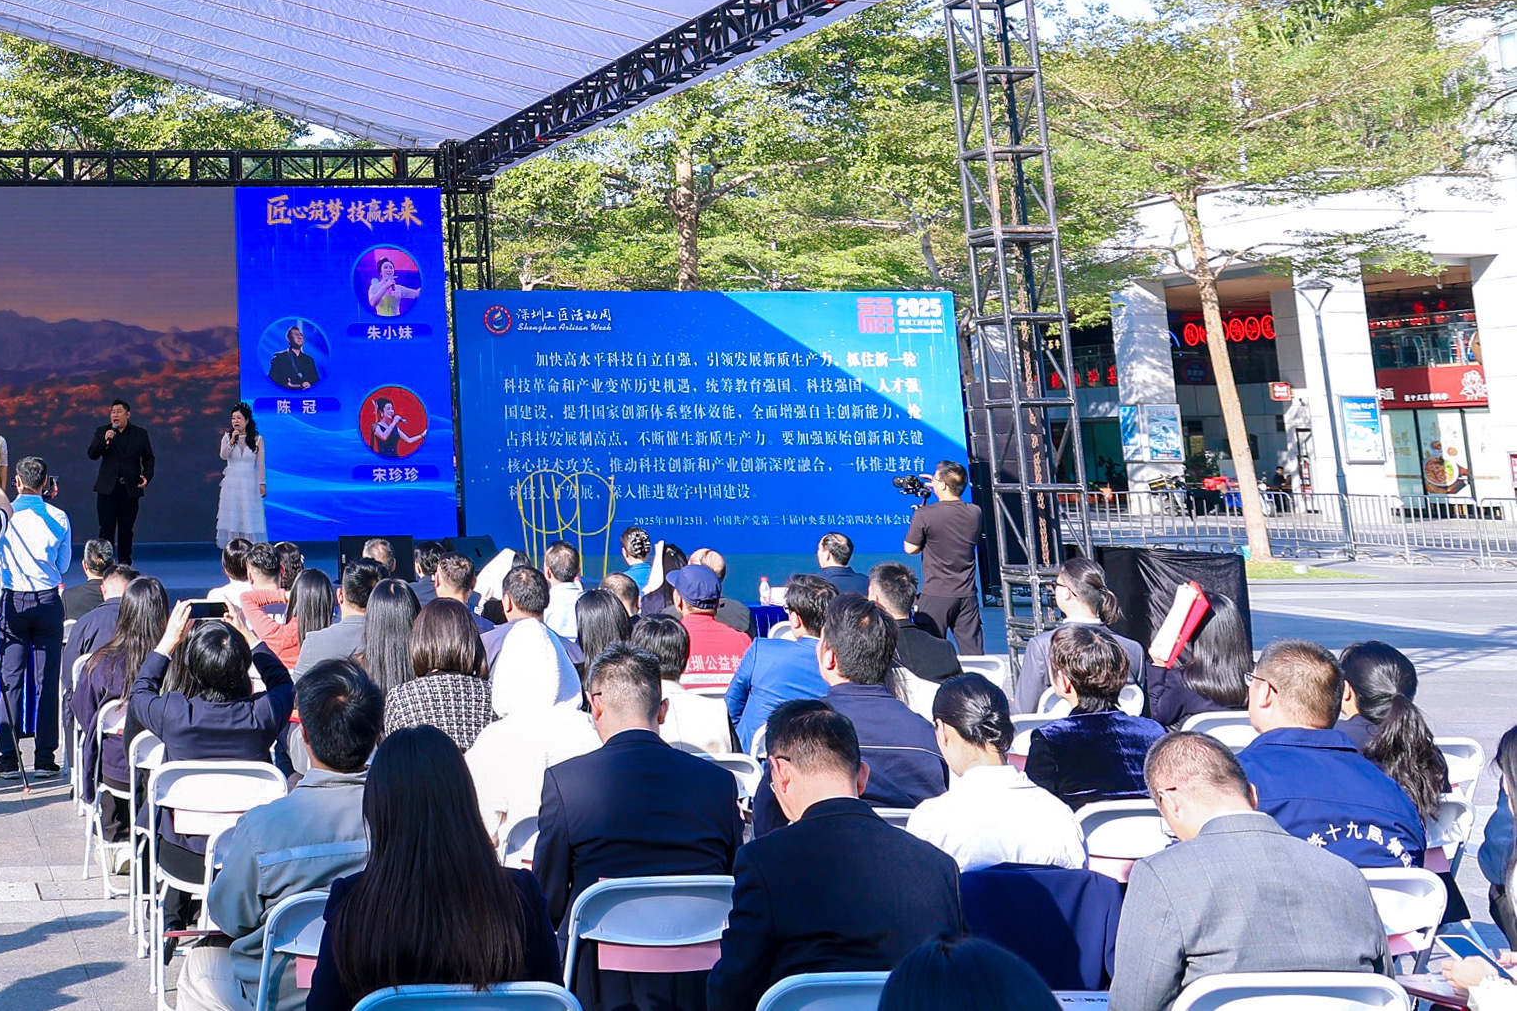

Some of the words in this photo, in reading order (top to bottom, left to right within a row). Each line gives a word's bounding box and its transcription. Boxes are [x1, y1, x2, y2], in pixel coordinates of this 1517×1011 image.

[267, 194, 344, 229] 匠心筑梦
[347, 196, 423, 231] 技赢未来
[516, 307, 612, 322] 深圳工匠活动周
[896, 297, 942, 317] 2025
[367, 324, 414, 341] 朱小妹
[517, 322, 557, 333] Shenzhen
[558, 322, 589, 331] Artisan
[590, 322, 612, 331] Week
[372, 466, 419, 483] 宋珍珍
